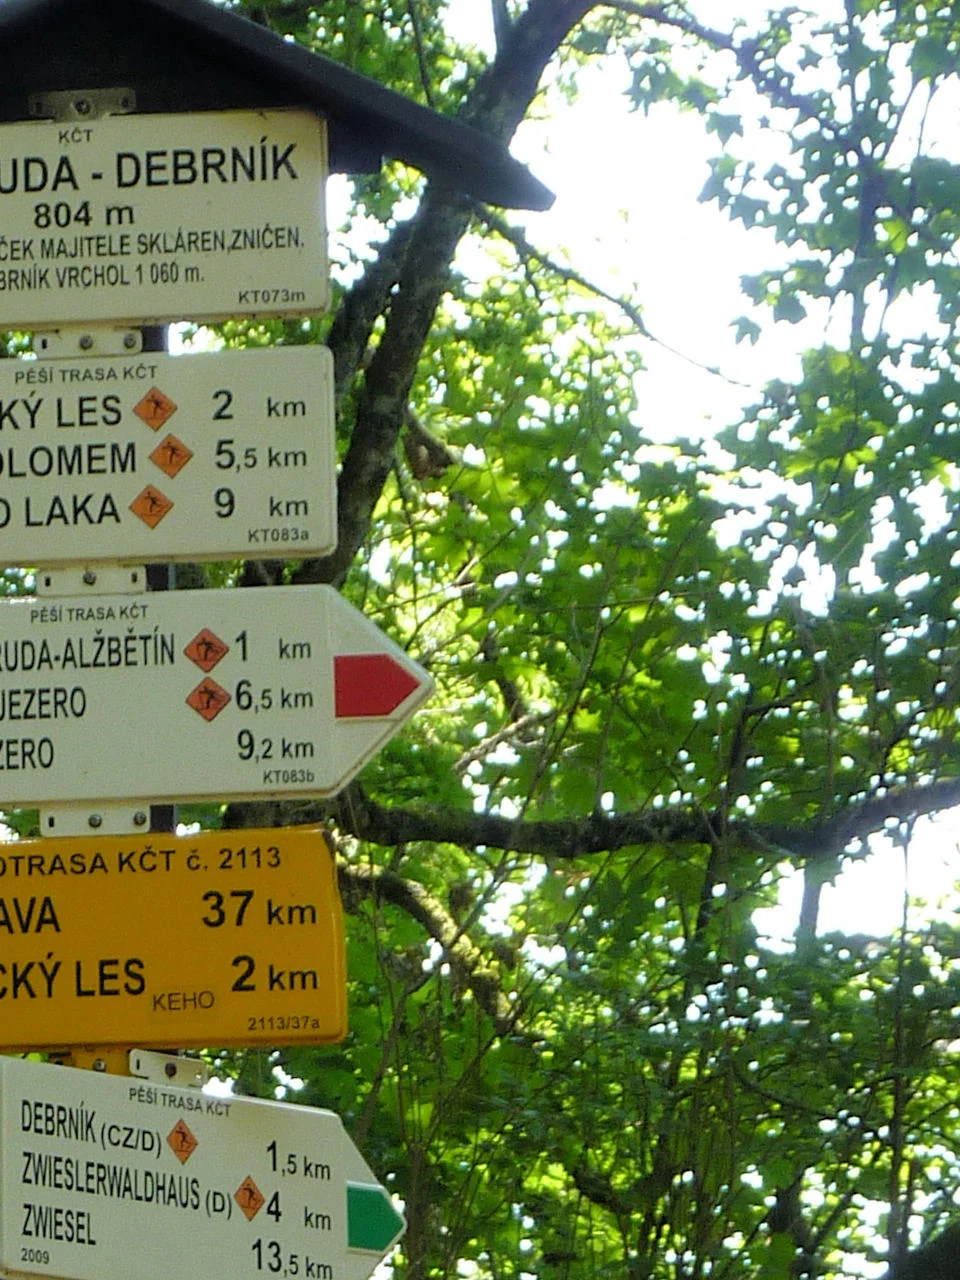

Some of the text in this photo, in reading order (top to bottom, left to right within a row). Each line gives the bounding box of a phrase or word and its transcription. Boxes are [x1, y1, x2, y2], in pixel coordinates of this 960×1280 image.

[58, 128, 94, 143] KČT
[117, 136, 299, 188] DEBRNÍK
[34, 202, 135, 228] 804 m
[41, 235, 130, 259] MAJITELE
[55, 266, 130, 288] VRCHOL
[136, 266, 144, 284] 1
[149, 264, 179, 284] 060
[184, 268, 204, 282] m.
[238, 288, 305, 304] KT073m
[14, 365, 158, 385] PĚŠÍ TRASA KČT
[56, 396, 122, 427] LES
[212, 390, 233, 420] 2
[267, 397, 306, 418] km
[215, 440, 257, 474] 5,5
[268, 448, 307, 468] km
[24, 494, 121, 527] LAKA
[214, 487, 236, 517] 9
[270, 497, 309, 517] km
[248, 529, 309, 543] KT083a
[30, 604, 148, 624] PĚŠÍ TRASA KČT
[235, 630, 249, 661] 1
[279, 638, 311, 660] km
[235, 680, 272, 713] 6,5
[281, 688, 313, 708] km
[237, 730, 273, 763] 9,2
[282, 738, 314, 759] km
[263, 769, 314, 784] KT083b
[118, 846, 175, 873] KČT
[186, 850, 207, 870] č.
[219, 846, 281, 870] 2113
[201, 890, 255, 928] 37
[267, 900, 316, 925] km
[75, 958, 146, 997] LES
[231, 955, 256, 992] 2
[269, 965, 318, 991] km
[152, 990, 215, 1012] KEHO
[248, 1016, 320, 1031] 2113/37a
[129, 1087, 232, 1117] PĚŠÍ TRASA KČT
[21, 1099, 331, 1180] DEBRNÍK (CZ/D) 1,5 km
[22, 1152, 331, 1231] ZWIESLERWALDHAUS (D) 4 km
[21, 1203, 333, 1280] ZWIESEL 13,5 km
[20, 1248, 49, 1265] 2009
